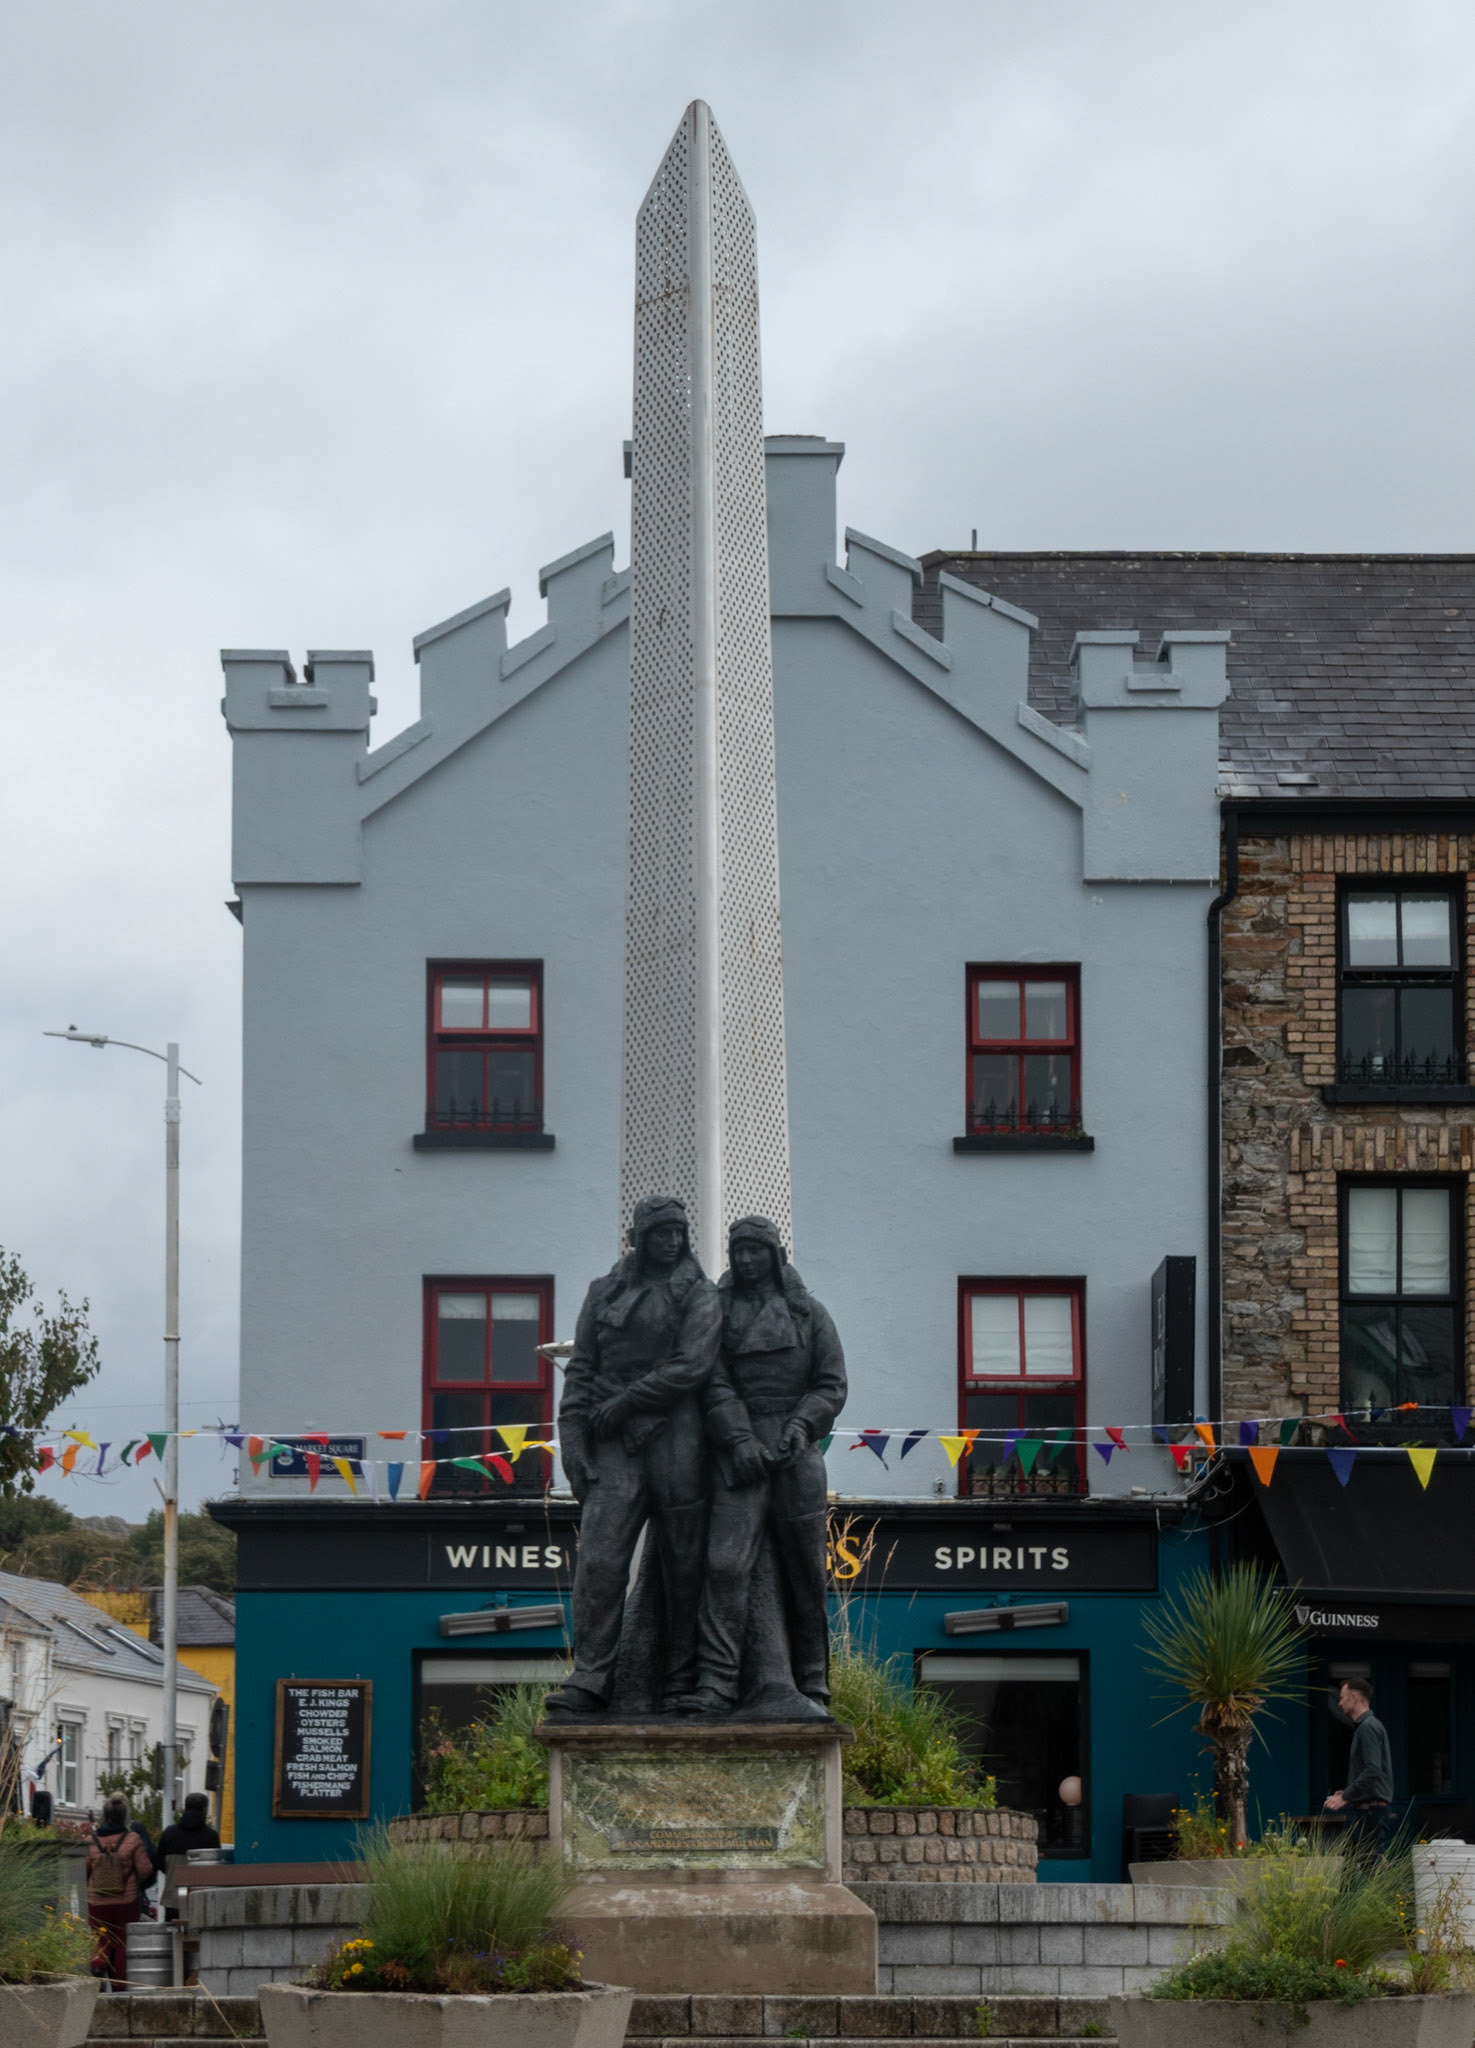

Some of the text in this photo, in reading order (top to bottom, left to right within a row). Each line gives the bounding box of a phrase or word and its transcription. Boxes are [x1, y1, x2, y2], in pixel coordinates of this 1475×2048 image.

[295, 1444, 359, 1454] MARKET SQUARE
[445, 1545, 563, 1568] WINES
[934, 1546, 1070, 1570] SPIRITS
[1310, 1611, 1380, 1628] GUINNESS
[288, 1689, 359, 1697] THE FISH BAR
[318, 1698, 350, 1707] KINGS
[298, 1709, 349, 1718] CHOWDER
[300, 1718, 346, 1727] OYSTERS
[296, 1727, 350, 1736] MUSSELLS
[302, 1737, 344, 1745] SMOKED
[302, 1745, 343, 1753] SALMON
[296, 1754, 321, 1762] CRAB
[286, 1763, 358, 1771] FRESH SALMON
[288, 1772, 310, 1780] FISH
[327, 1772, 355, 1780] CHIPS
[300, 1789, 343, 1797] PLATTER
